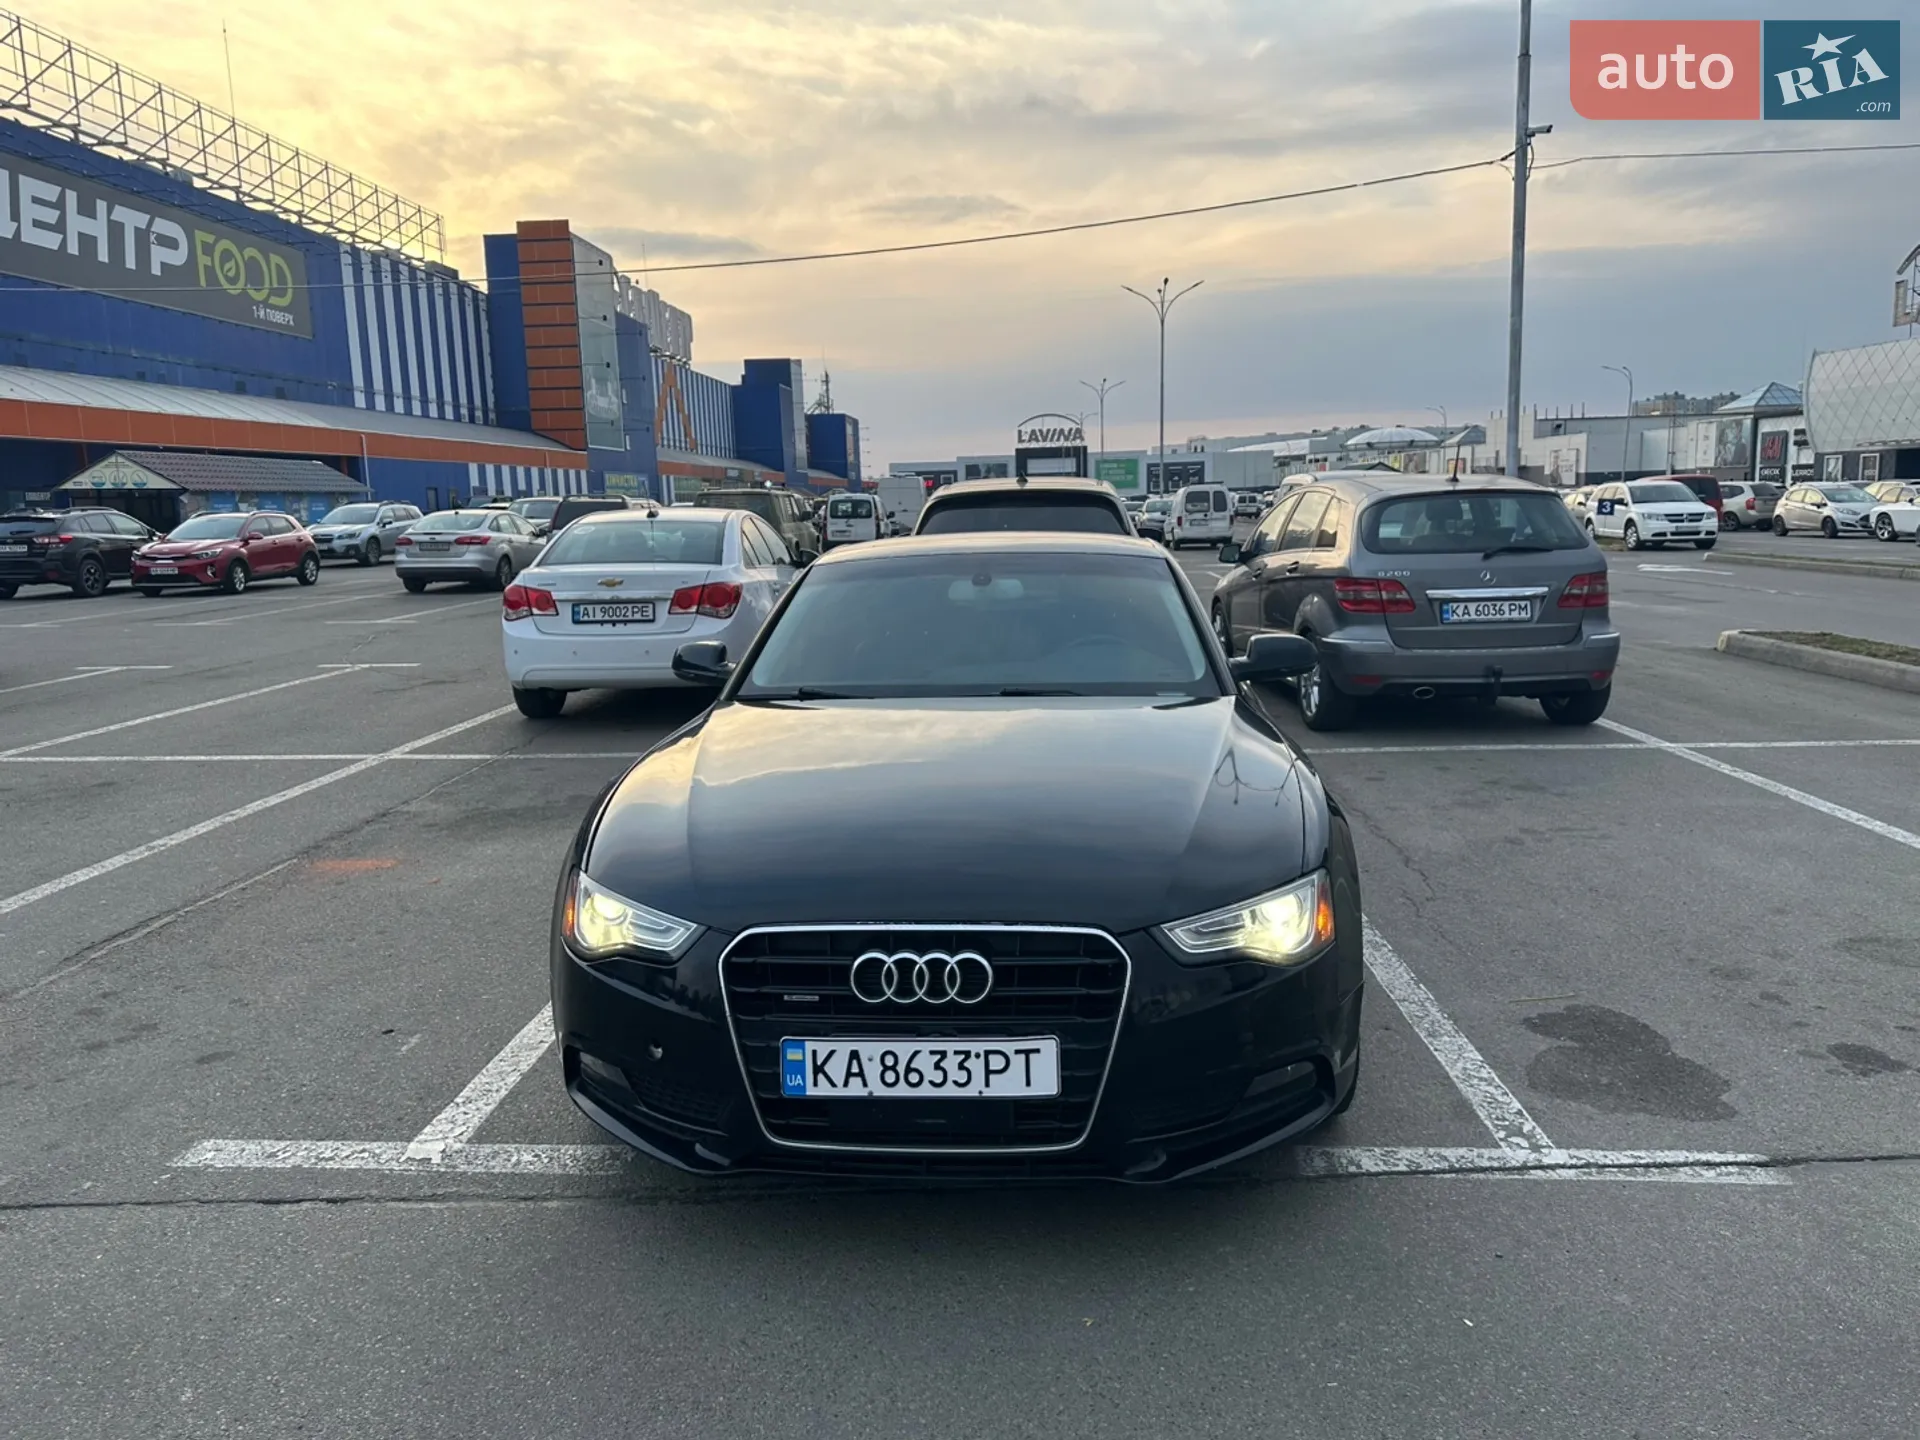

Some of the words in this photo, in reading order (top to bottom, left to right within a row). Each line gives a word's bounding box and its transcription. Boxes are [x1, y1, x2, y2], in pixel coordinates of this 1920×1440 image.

[194, 229, 294, 307] FOOD
[266, 308, 295, 326] ПОВЕРХ
[1601, 501, 1611, 513] 3
[581, 606, 596, 619] AI
[600, 606, 629, 618] 9002
[631, 605, 650, 618] PE
[1451, 604, 1471, 618] KA
[1474, 603, 1505, 617] 6036
[1508, 602, 1529, 616] PM
[811, 1049, 868, 1089] KA
[879, 1049, 972, 1088] 8633
[983, 1047, 1042, 1088] PT
[786, 1074, 804, 1086] UA
